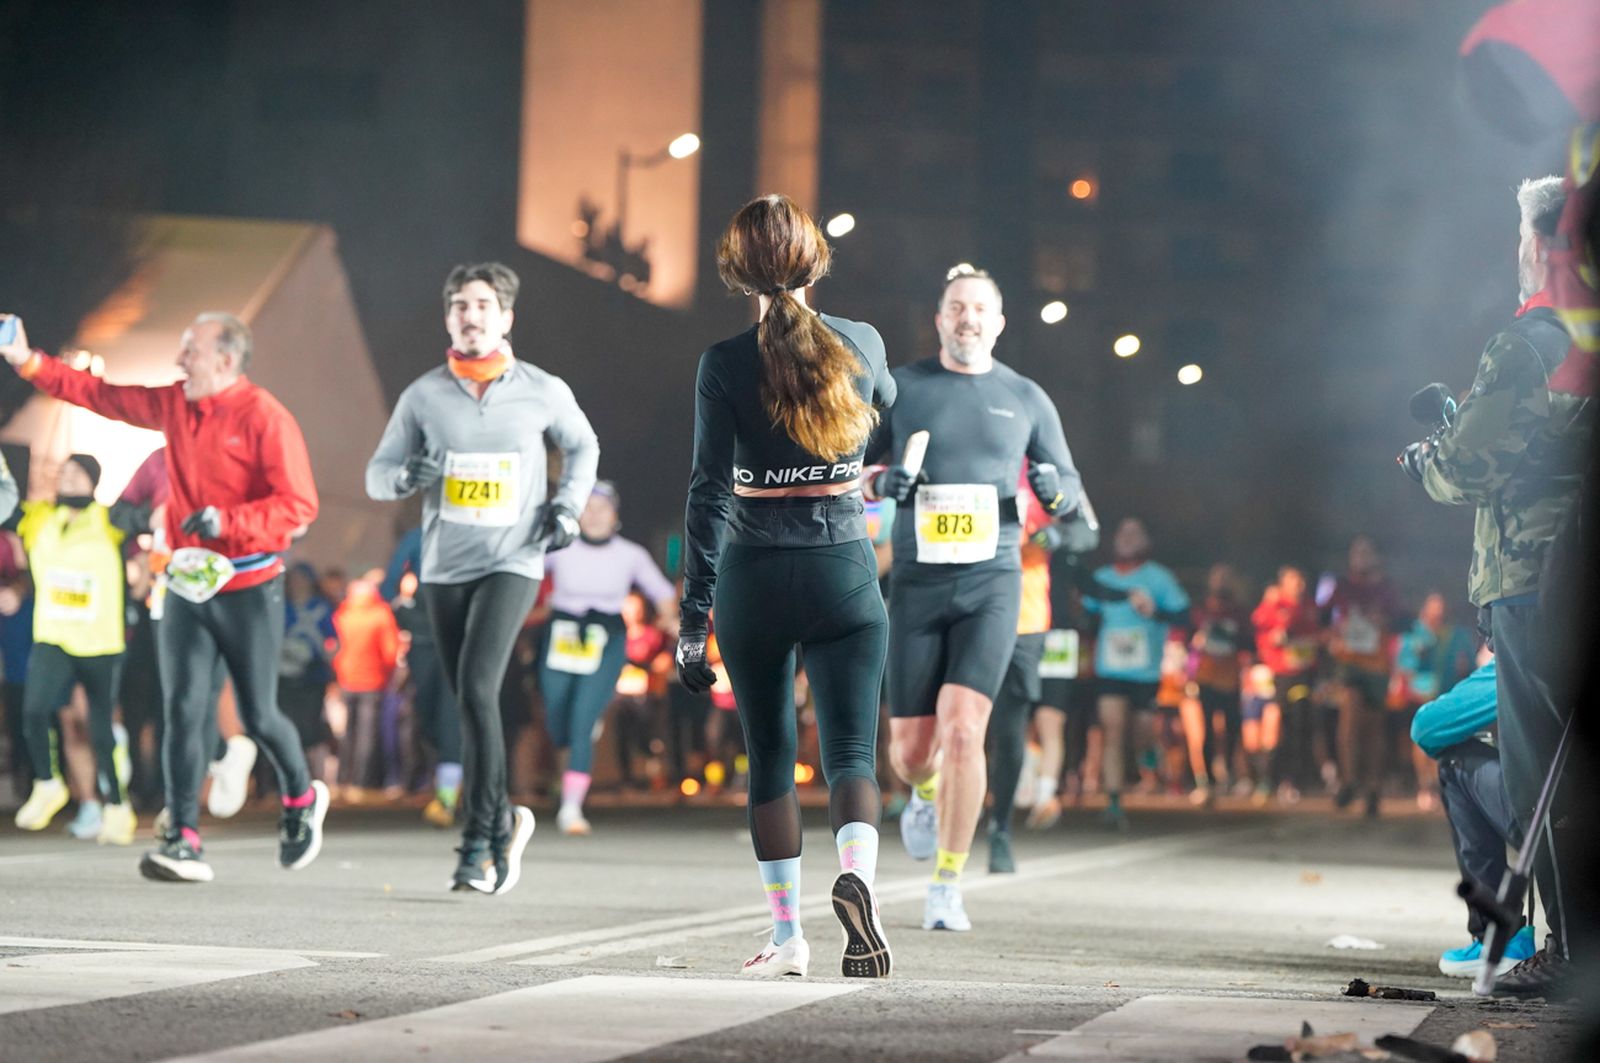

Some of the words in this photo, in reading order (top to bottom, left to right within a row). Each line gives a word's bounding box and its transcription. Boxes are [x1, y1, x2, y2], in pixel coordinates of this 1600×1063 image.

[764, 465, 827, 484] NIKE
[830, 458, 864, 479] PR
[457, 481, 500, 500] 7241
[937, 514, 973, 535] 873
